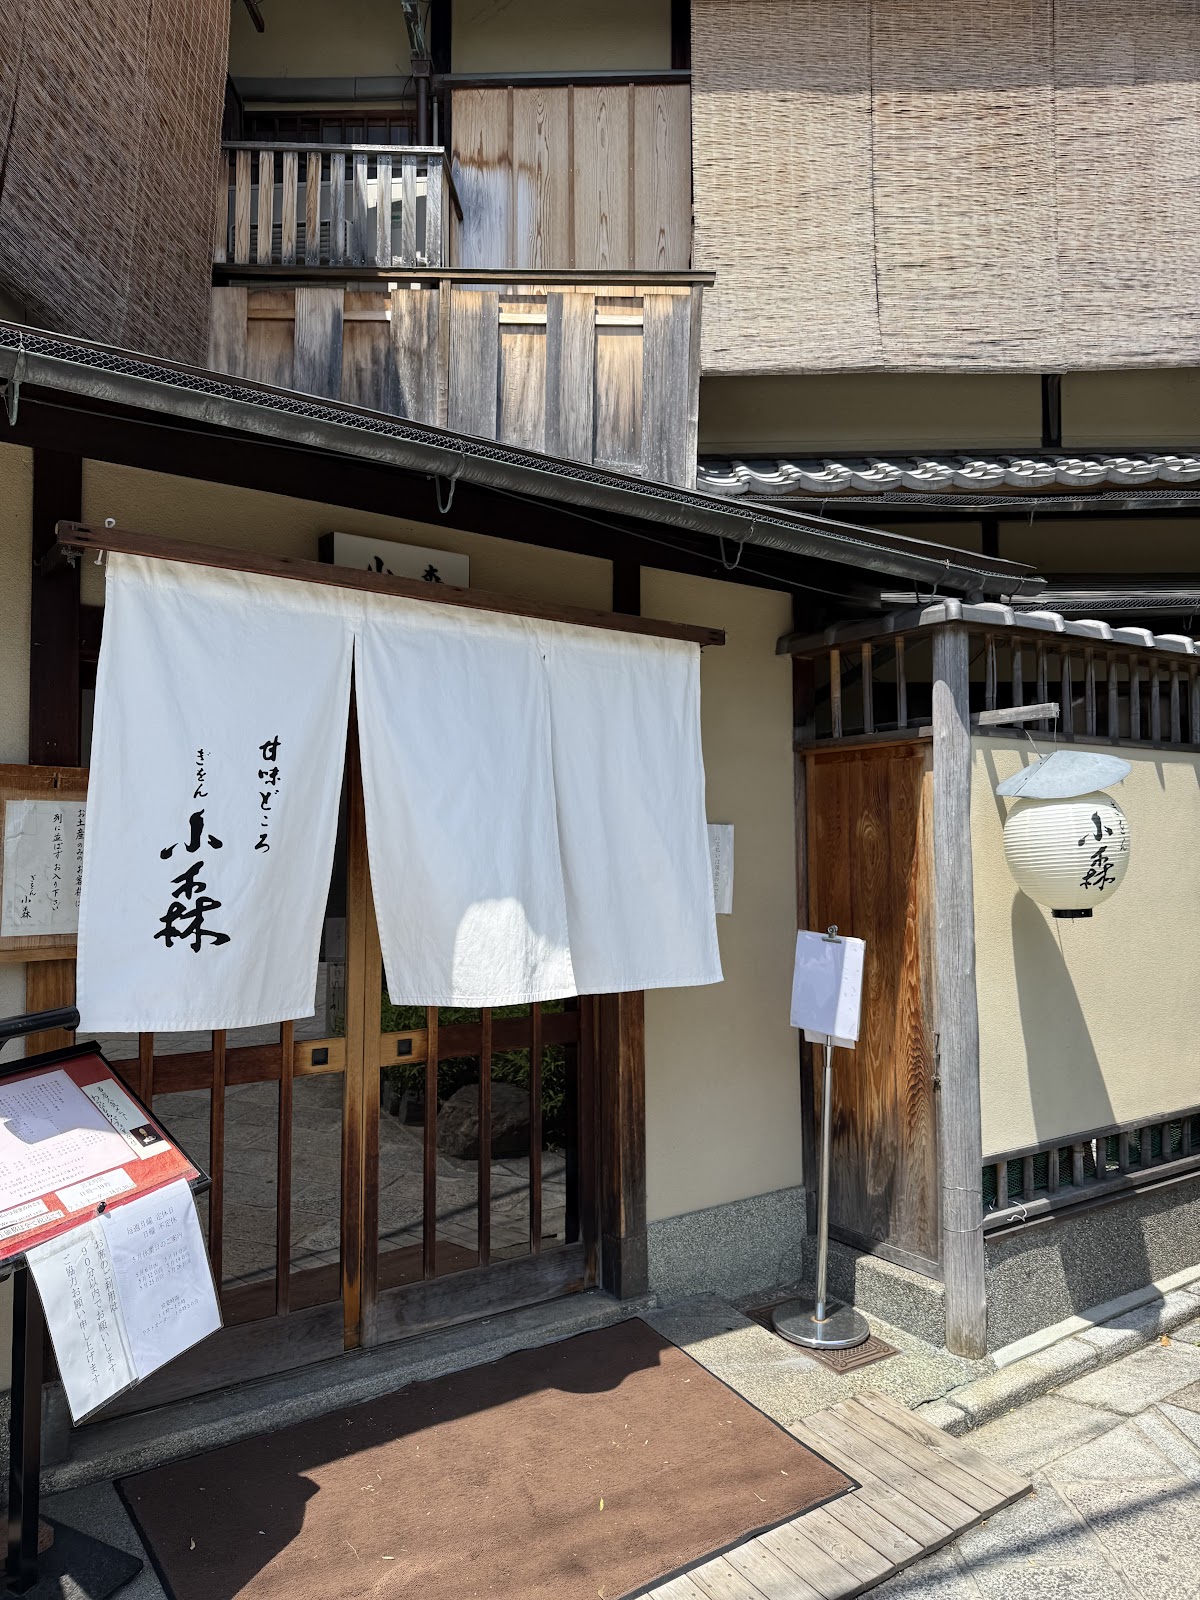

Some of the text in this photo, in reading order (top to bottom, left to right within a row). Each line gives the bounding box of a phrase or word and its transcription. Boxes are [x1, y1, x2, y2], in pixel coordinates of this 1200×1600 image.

[254, 735, 281, 853] 甘味どころ
[1077, 811, 1116, 891] 小森
[153, 808, 231, 953] 小森
[62, 1253, 100, 1385] ご協力お願い申し上げます
[94, 1239, 119, 1314] お席のご利用は
